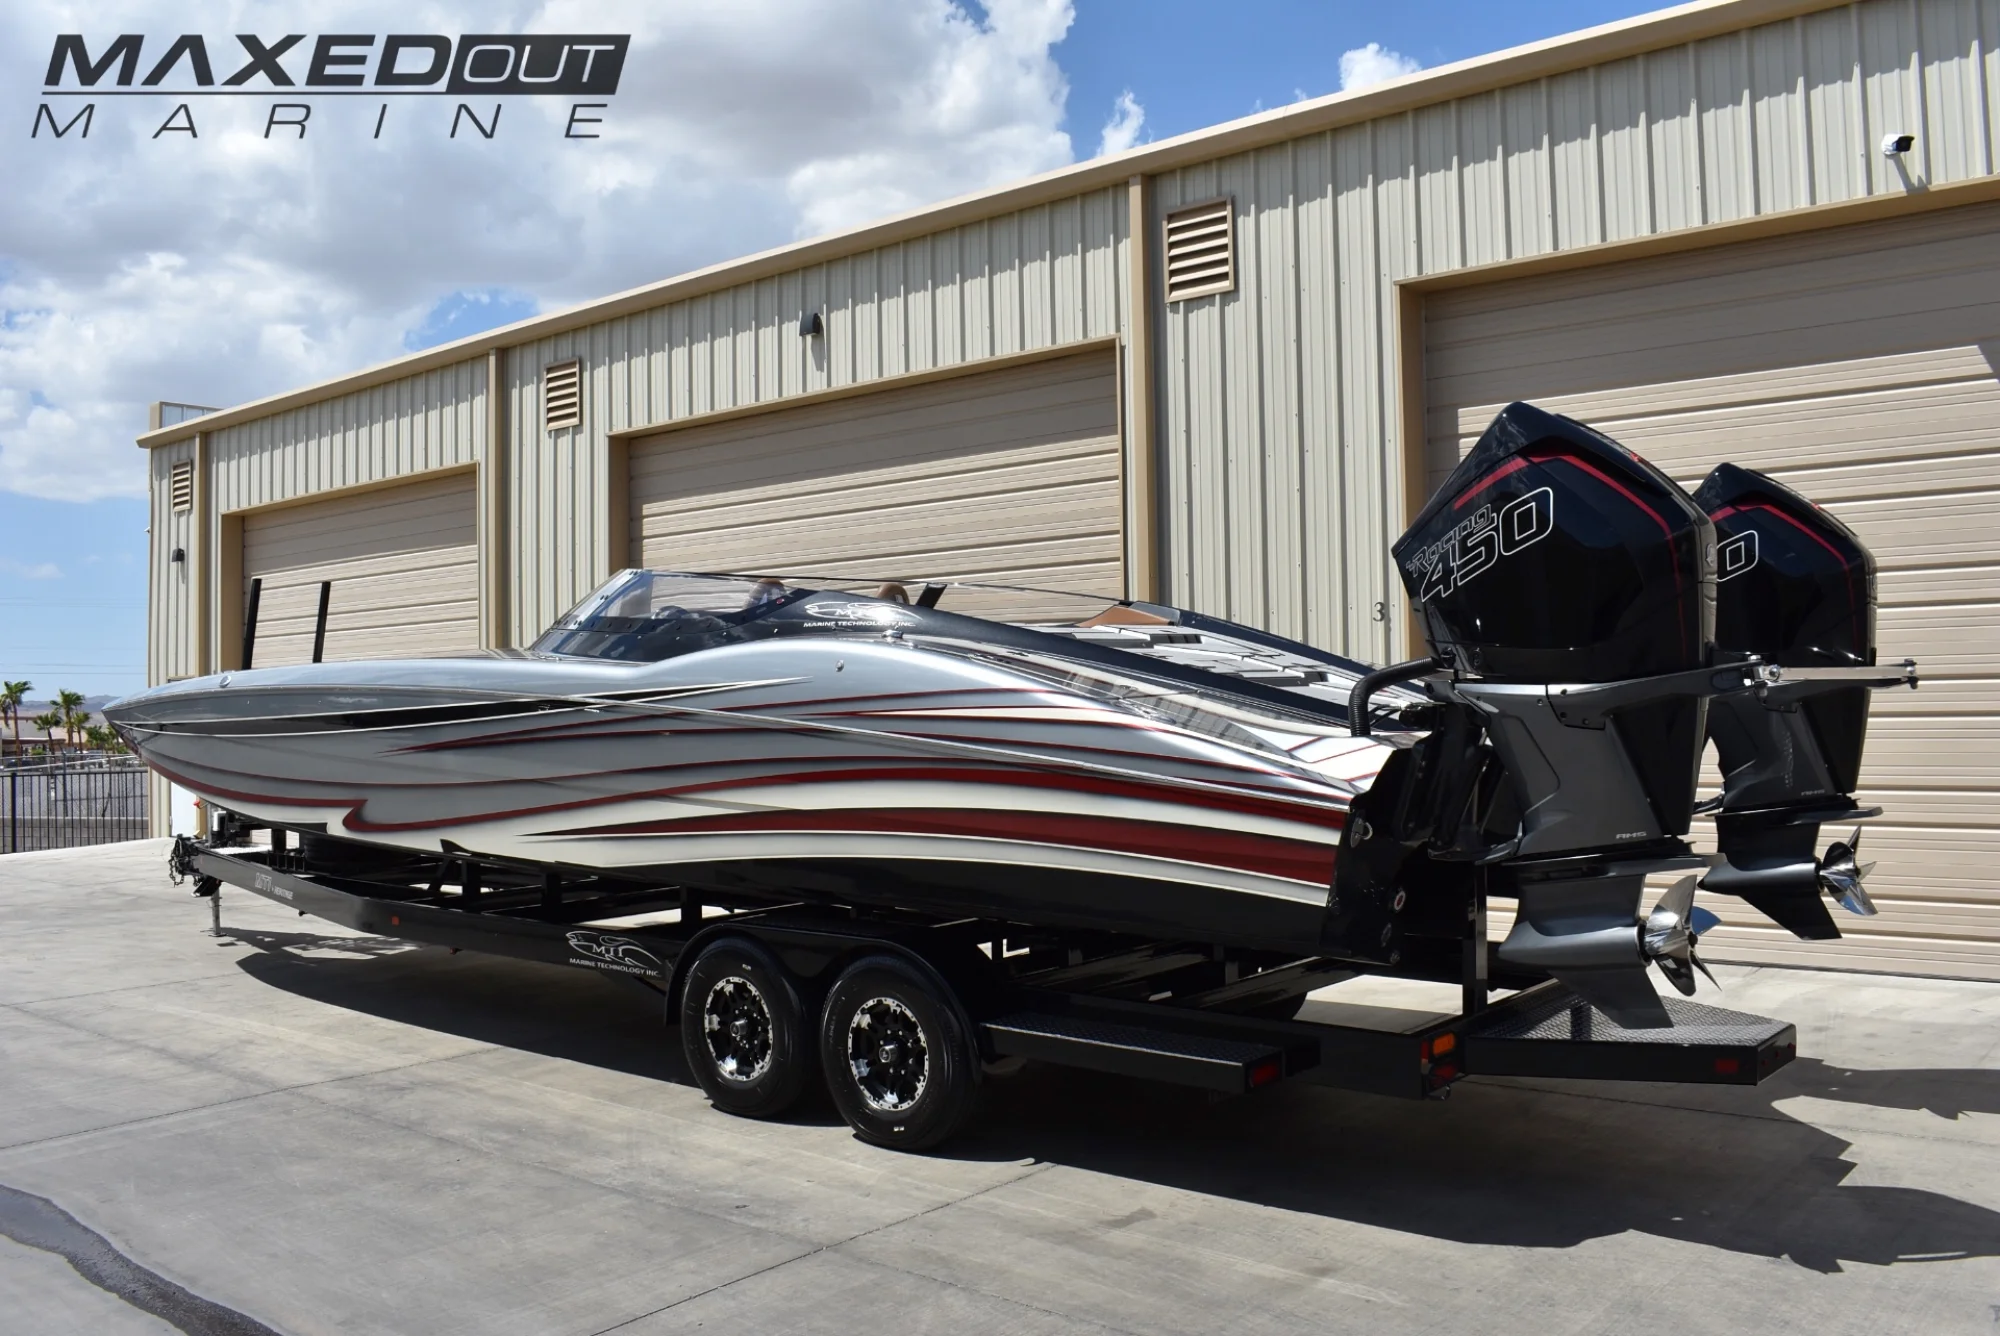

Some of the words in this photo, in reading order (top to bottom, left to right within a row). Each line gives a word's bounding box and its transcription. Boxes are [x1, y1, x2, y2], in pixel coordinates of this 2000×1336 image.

[1406, 503, 1492, 578] Racing
[1420, 486, 1554, 603] 450
[1372, 601, 1386, 622] 3
[1615, 830, 1647, 840] AMS
[570, 958, 596, 967] MARINE
[597, 962, 645, 975] TECHNOLOGY
